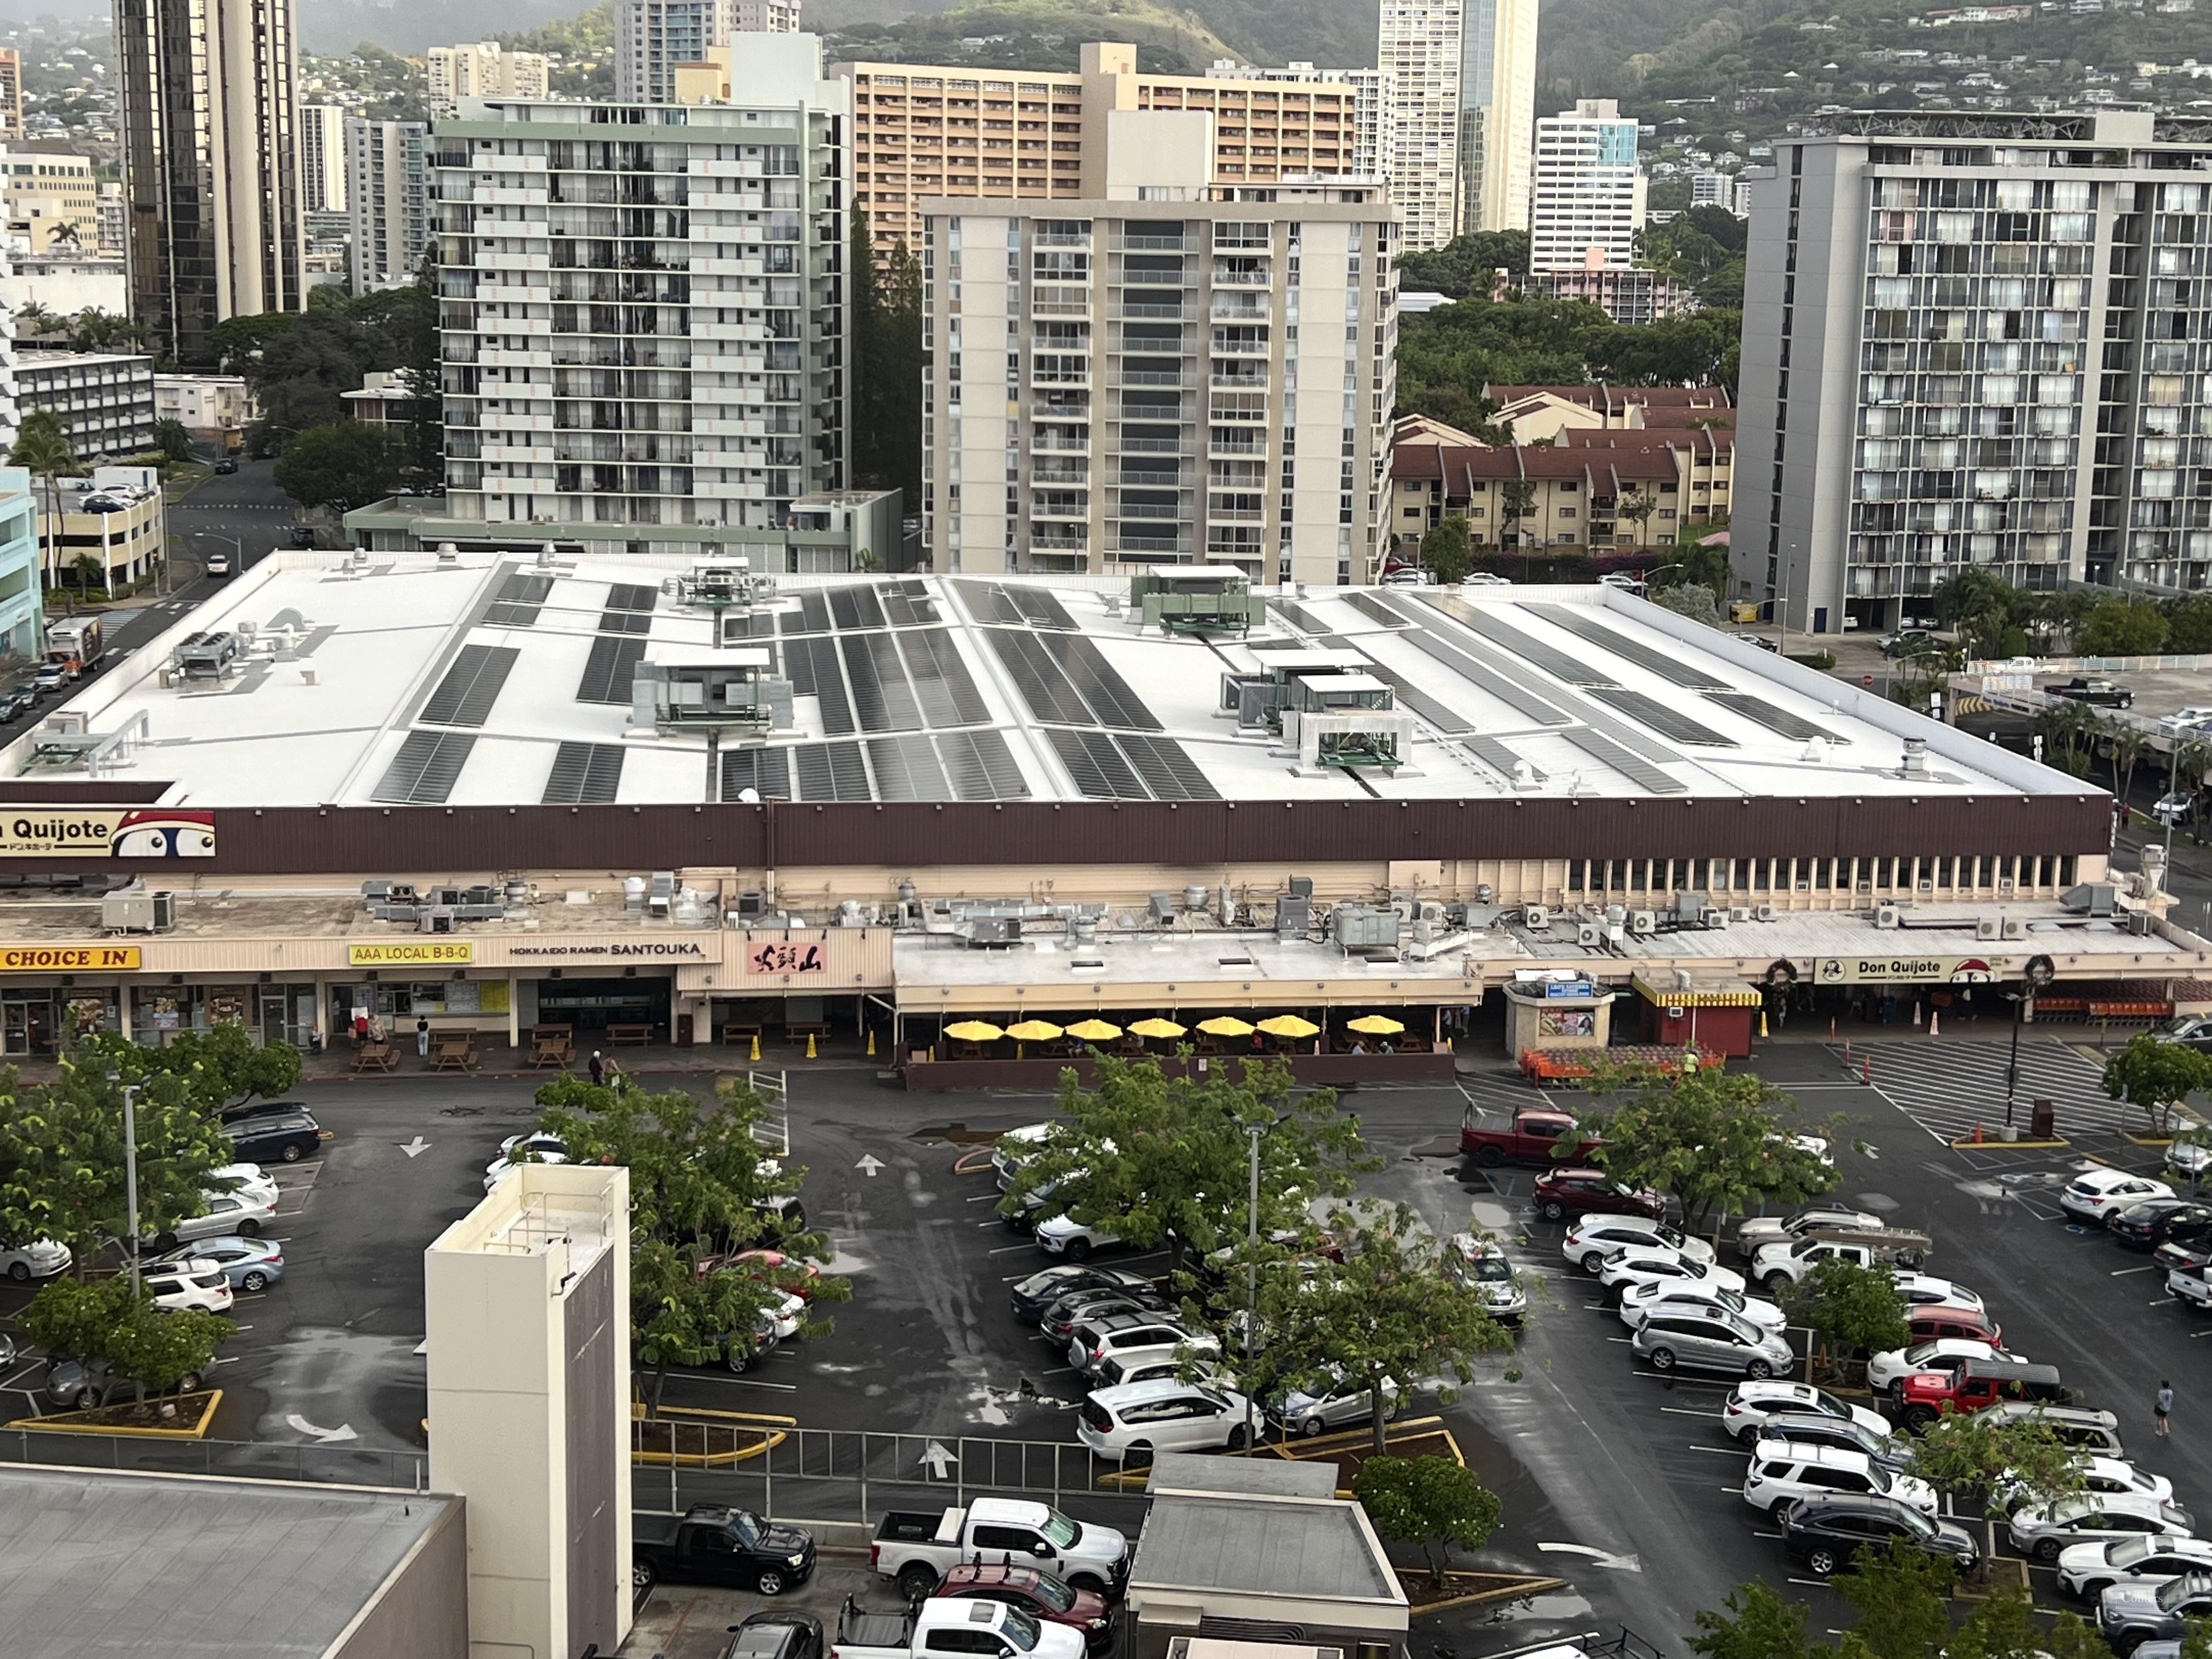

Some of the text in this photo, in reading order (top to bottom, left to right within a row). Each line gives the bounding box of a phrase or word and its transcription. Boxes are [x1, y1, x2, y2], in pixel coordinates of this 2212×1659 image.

[13, 819, 108, 842] Quijote
[356, 948, 381, 959] AAA
[386, 947, 429, 959] LOCAL
[611, 943, 701, 955] SANTOUKA
[5, 950, 128, 966] CHOICE IN
[1859, 961, 1940, 974] Don Quijote
